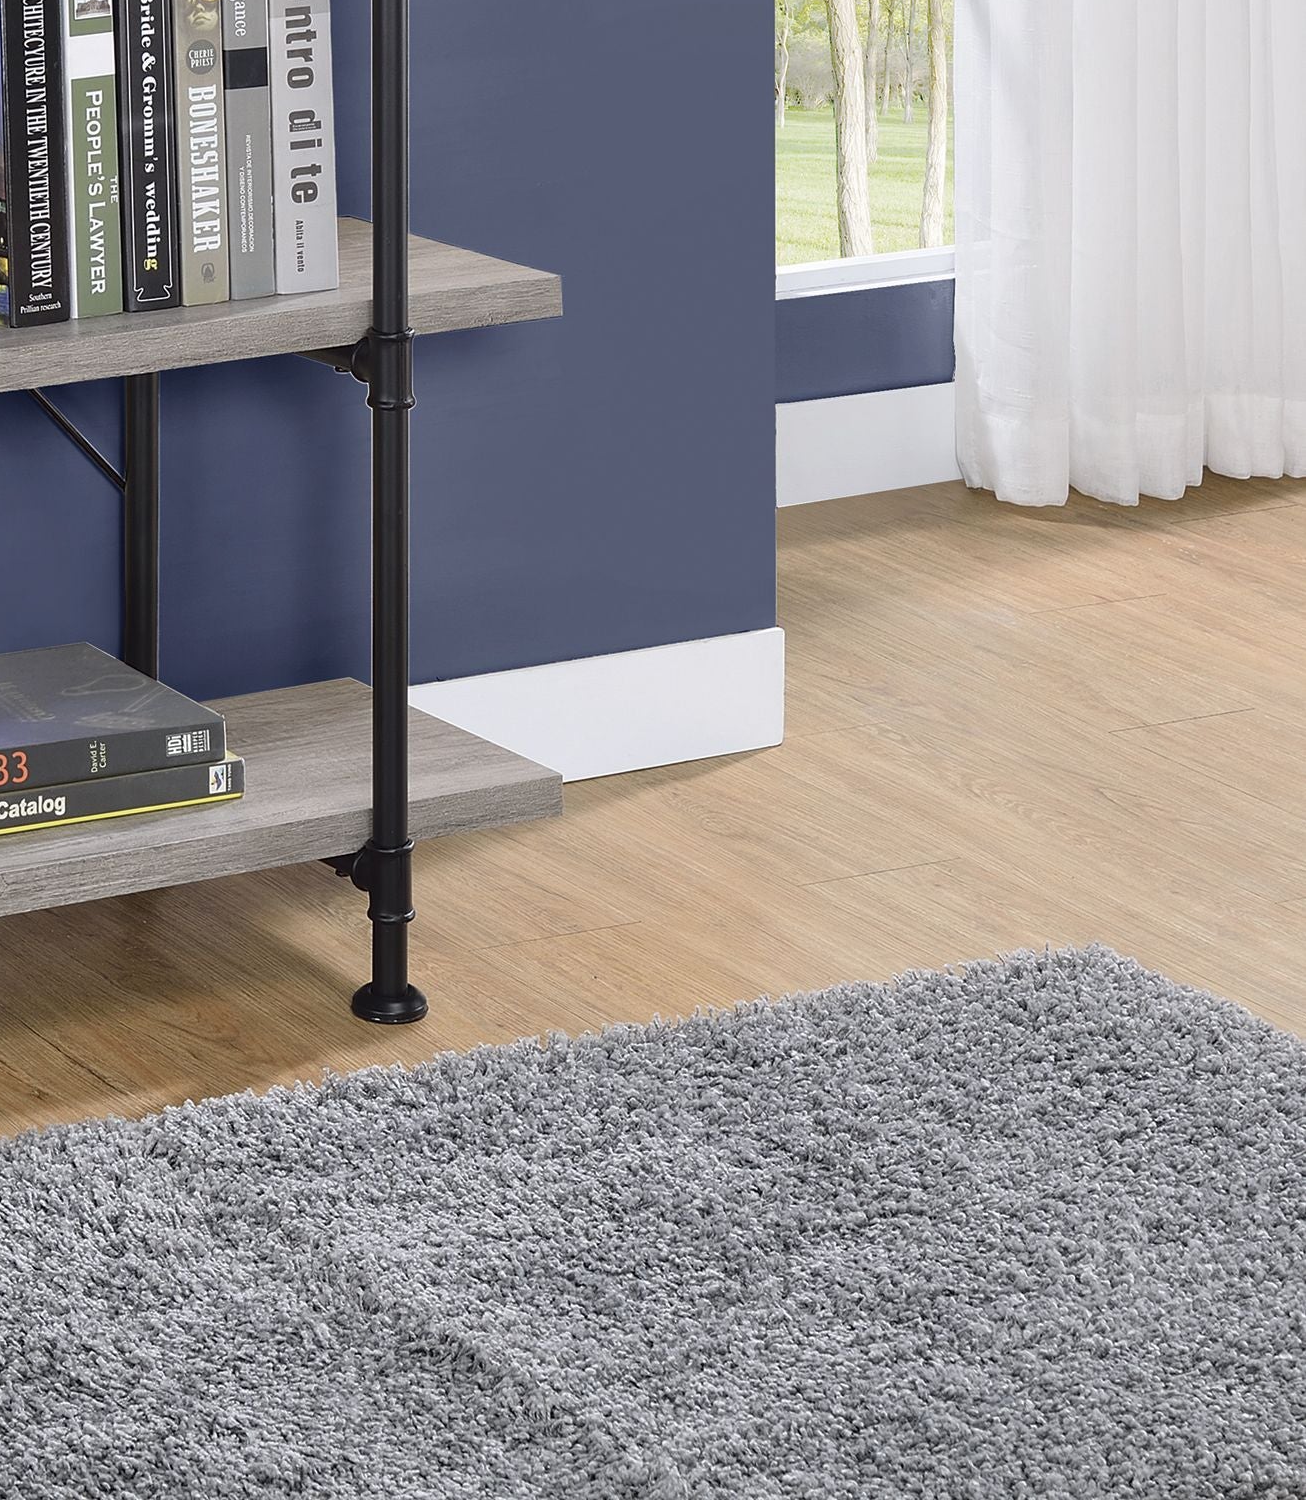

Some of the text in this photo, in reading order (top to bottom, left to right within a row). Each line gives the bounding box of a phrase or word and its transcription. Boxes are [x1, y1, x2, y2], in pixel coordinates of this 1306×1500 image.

[141, 51, 156, 73] &
[188, 48, 214, 59] CHERIE
[190, 57, 214, 68] PRIEST
[25, 87, 46, 104] IN
[26, 104, 48, 136] THE
[142, 76, 159, 174] Gromm's
[288, 109, 323, 151] di
[27, 135, 51, 221] TWENTIETH
[188, 83, 221, 253] BONESHAKER
[85, 89, 106, 294] PEOPLE'S LAWYER
[109, 175, 119, 203] THE
[290, 163, 323, 204] te
[143, 181, 161, 271] wedding
[295, 219, 304, 241] Abita
[29, 223, 53, 288] CENTURY
[296, 250, 305, 272] vento
[29, 292, 53, 302] Southern
[40, 300, 62, 312] research
[90, 750, 99, 773] David
[99, 742, 107, 768] Carter
